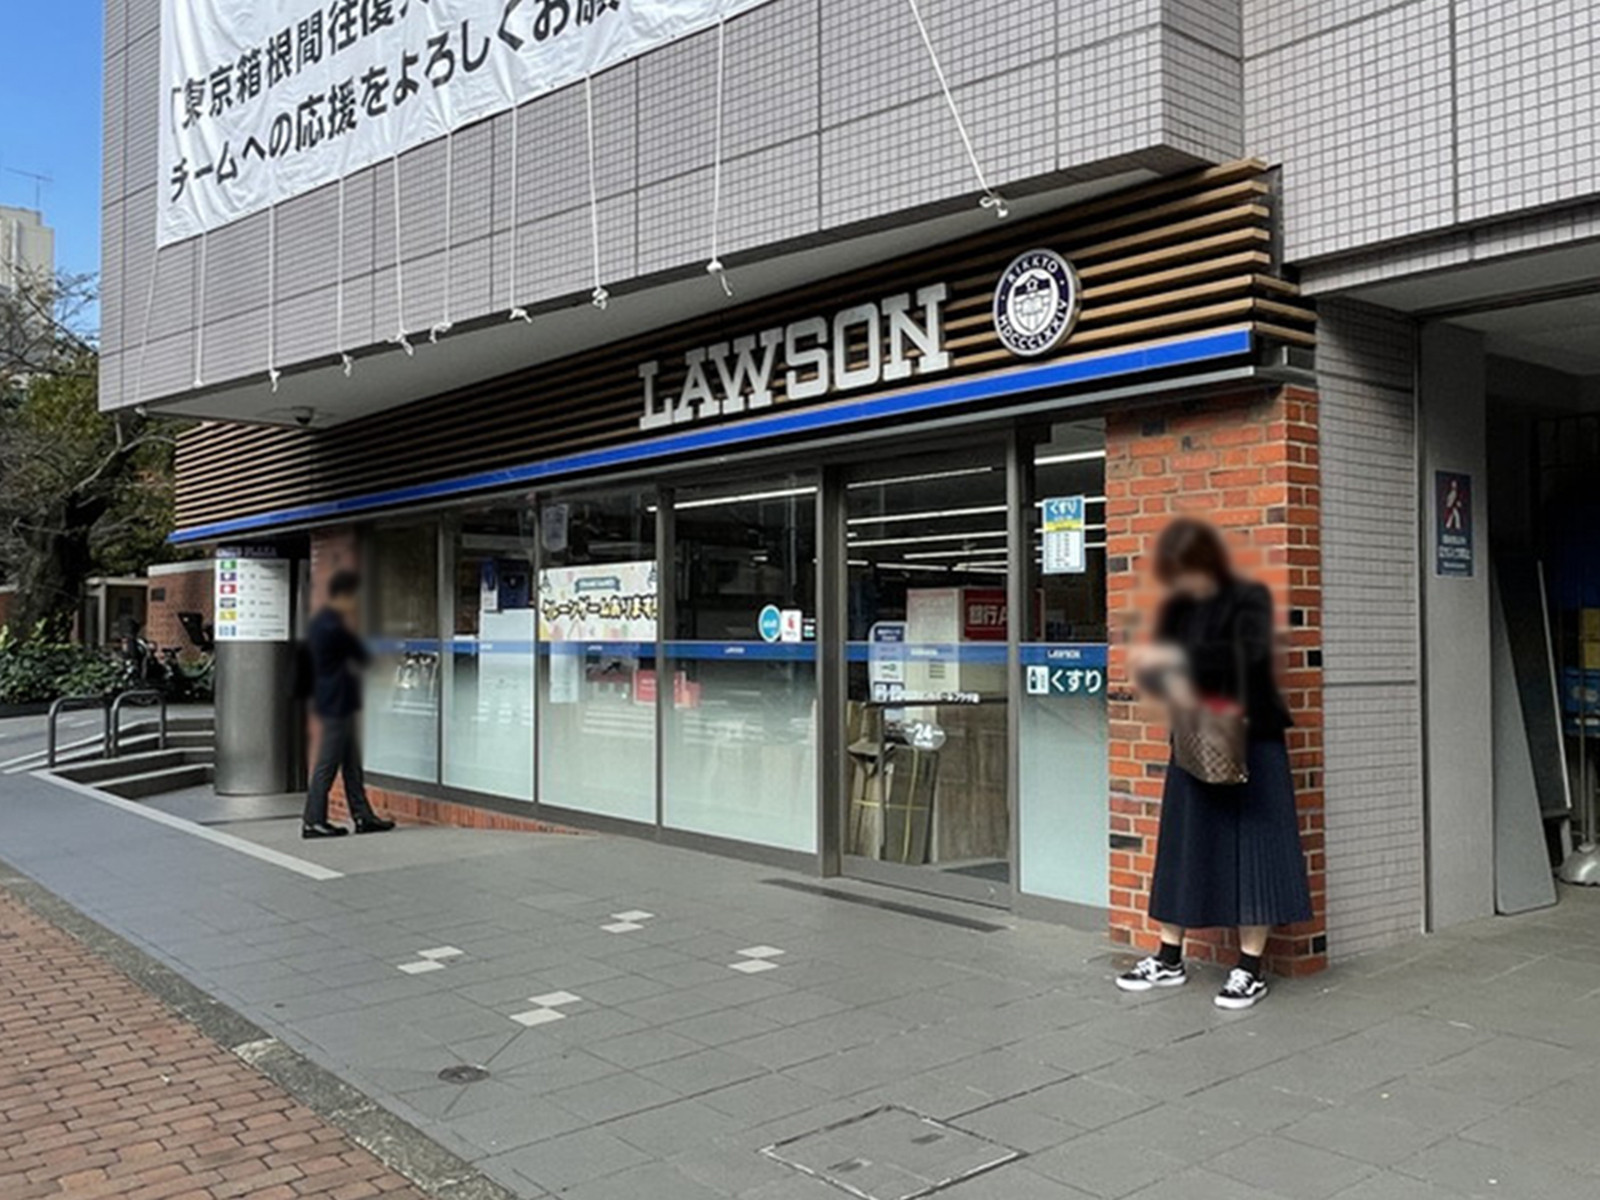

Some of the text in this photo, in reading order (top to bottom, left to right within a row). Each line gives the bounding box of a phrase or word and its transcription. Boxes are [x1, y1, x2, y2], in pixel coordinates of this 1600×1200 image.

[171, 0, 429, 134] 「東京箱根間往復
[638, 282, 951, 430] LAWSON
[1051, 669, 1103, 693] くすり
[914, 722, 933, 740] 24
